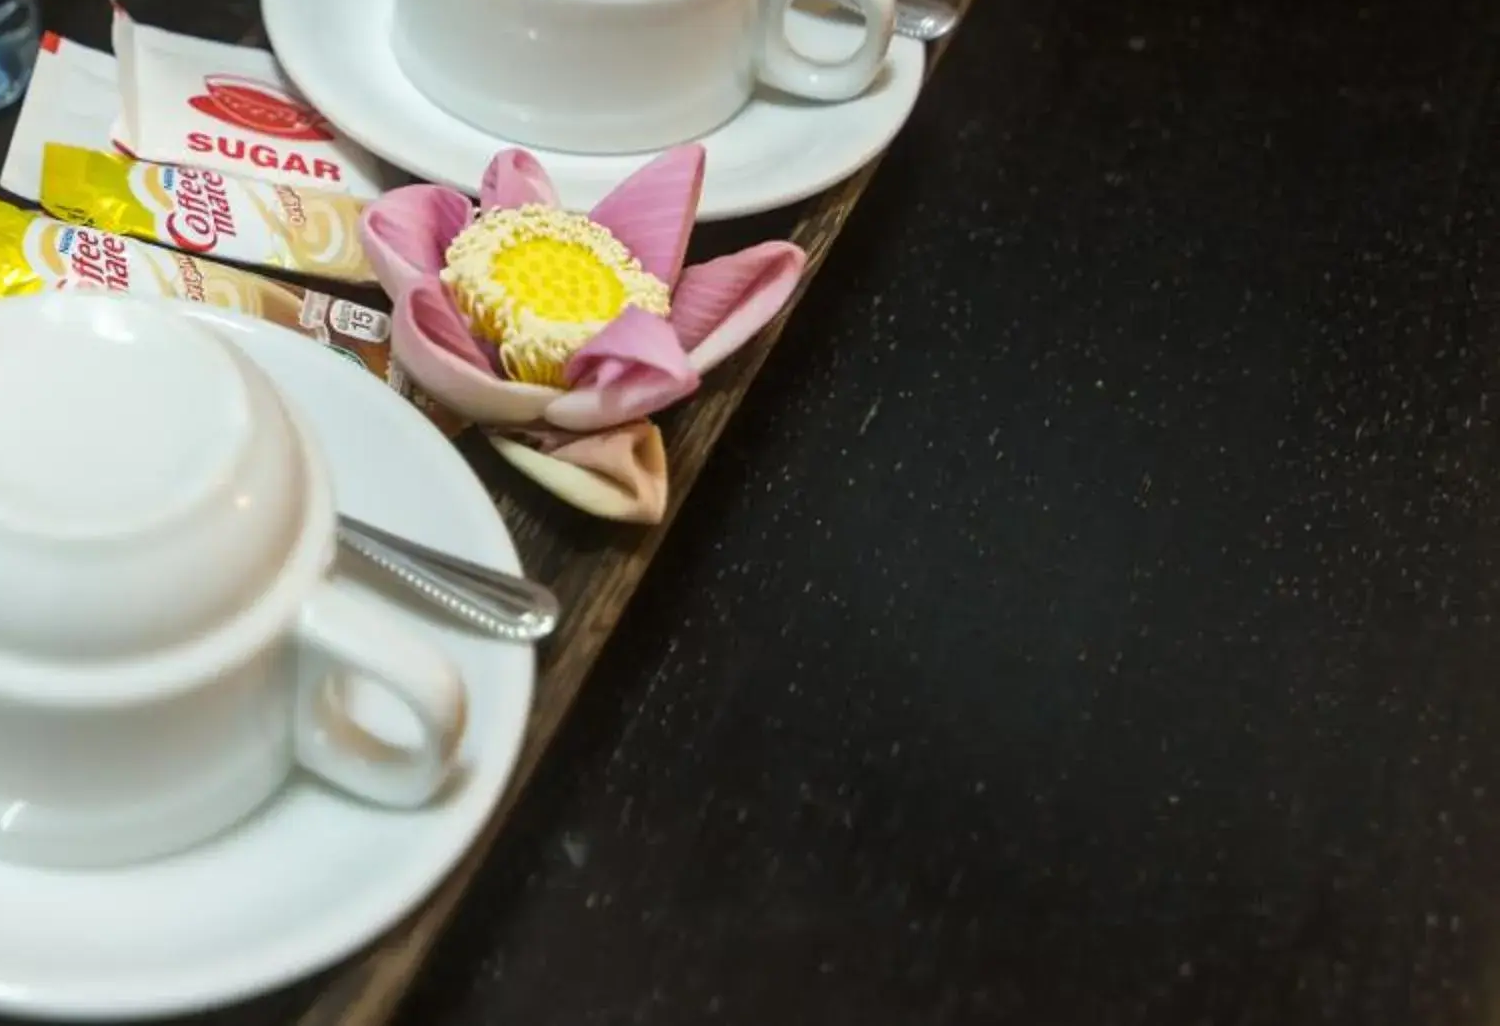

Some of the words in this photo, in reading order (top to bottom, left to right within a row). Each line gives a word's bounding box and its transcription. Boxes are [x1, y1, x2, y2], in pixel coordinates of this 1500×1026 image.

[187, 132, 342, 182] SUGAR
[165, 167, 218, 253] Coffee
[201, 170, 237, 238] mate
[350, 310, 374, 331] 15
